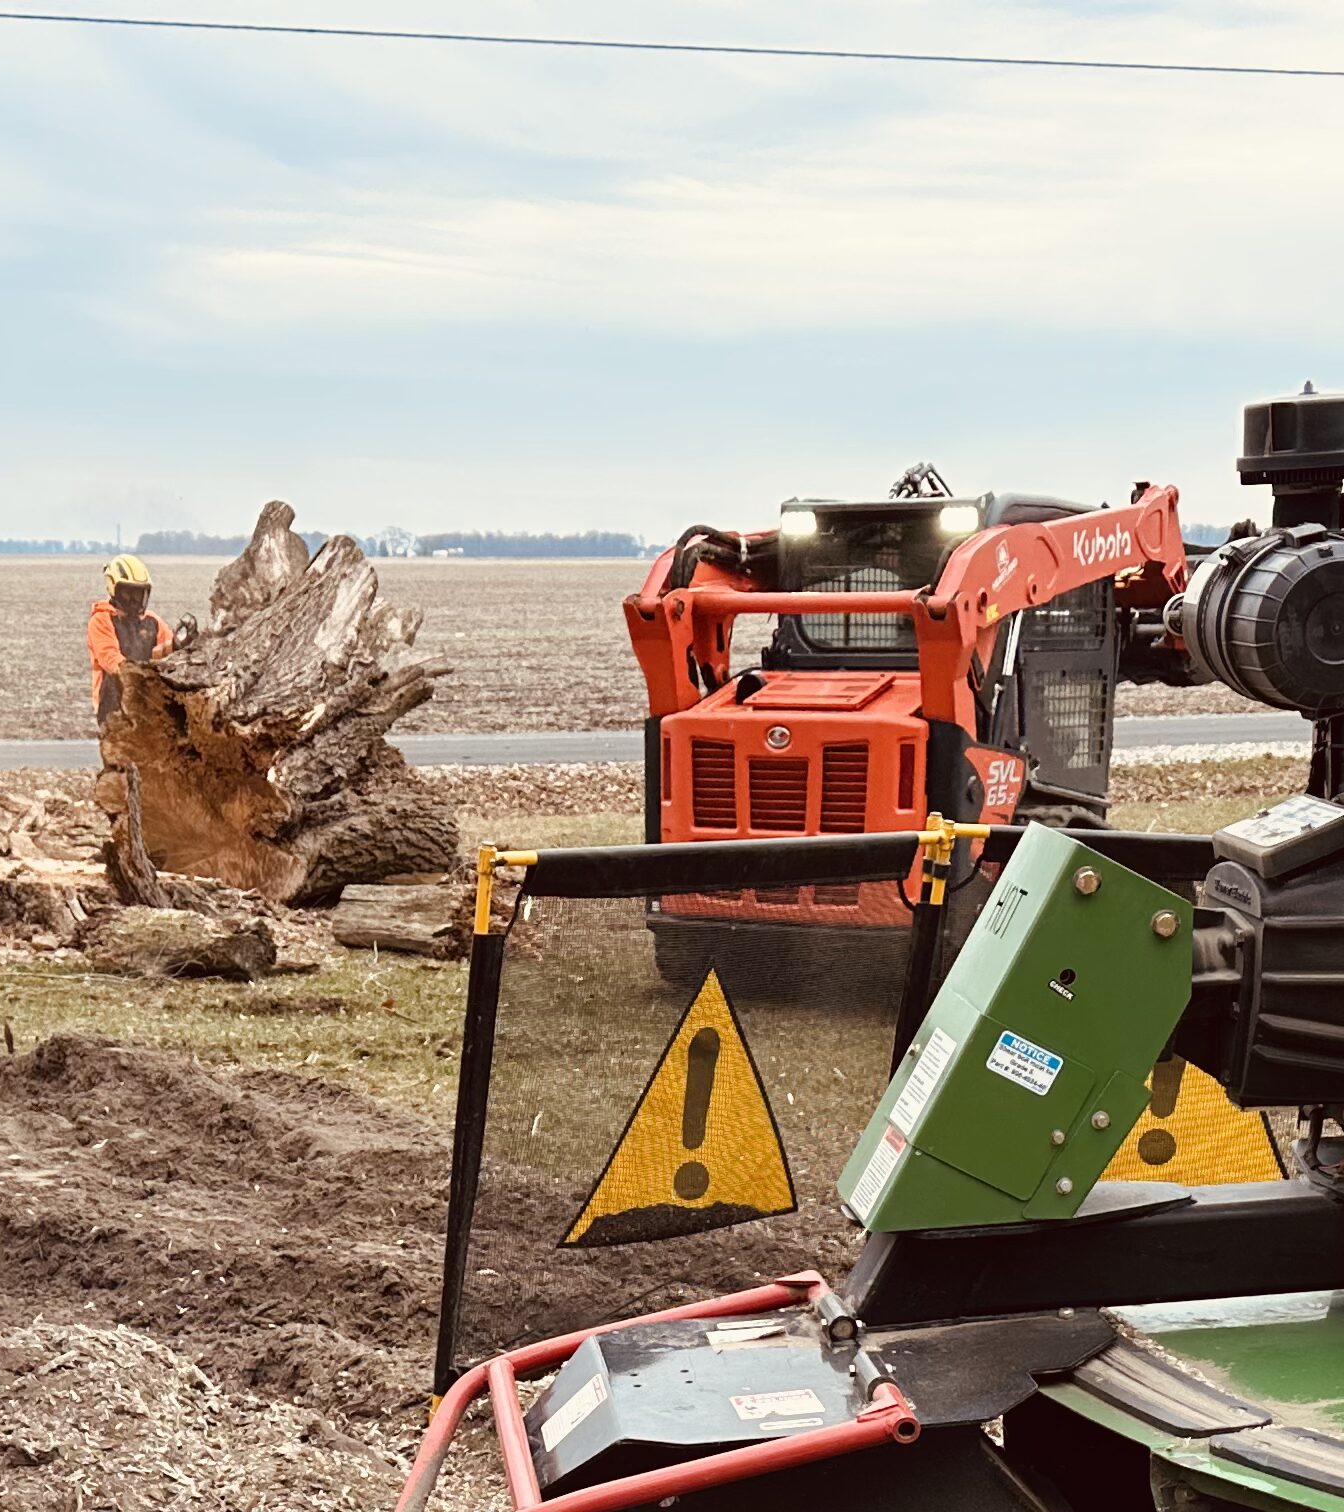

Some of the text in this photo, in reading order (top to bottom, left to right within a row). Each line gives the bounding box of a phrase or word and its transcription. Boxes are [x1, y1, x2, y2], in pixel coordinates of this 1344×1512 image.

[1073, 522, 1131, 566] Kubota
[987, 759, 1021, 785] SVL
[1049, 980, 1074, 1001] CHECK
[1010, 1038, 1052, 1066] NOTICE
